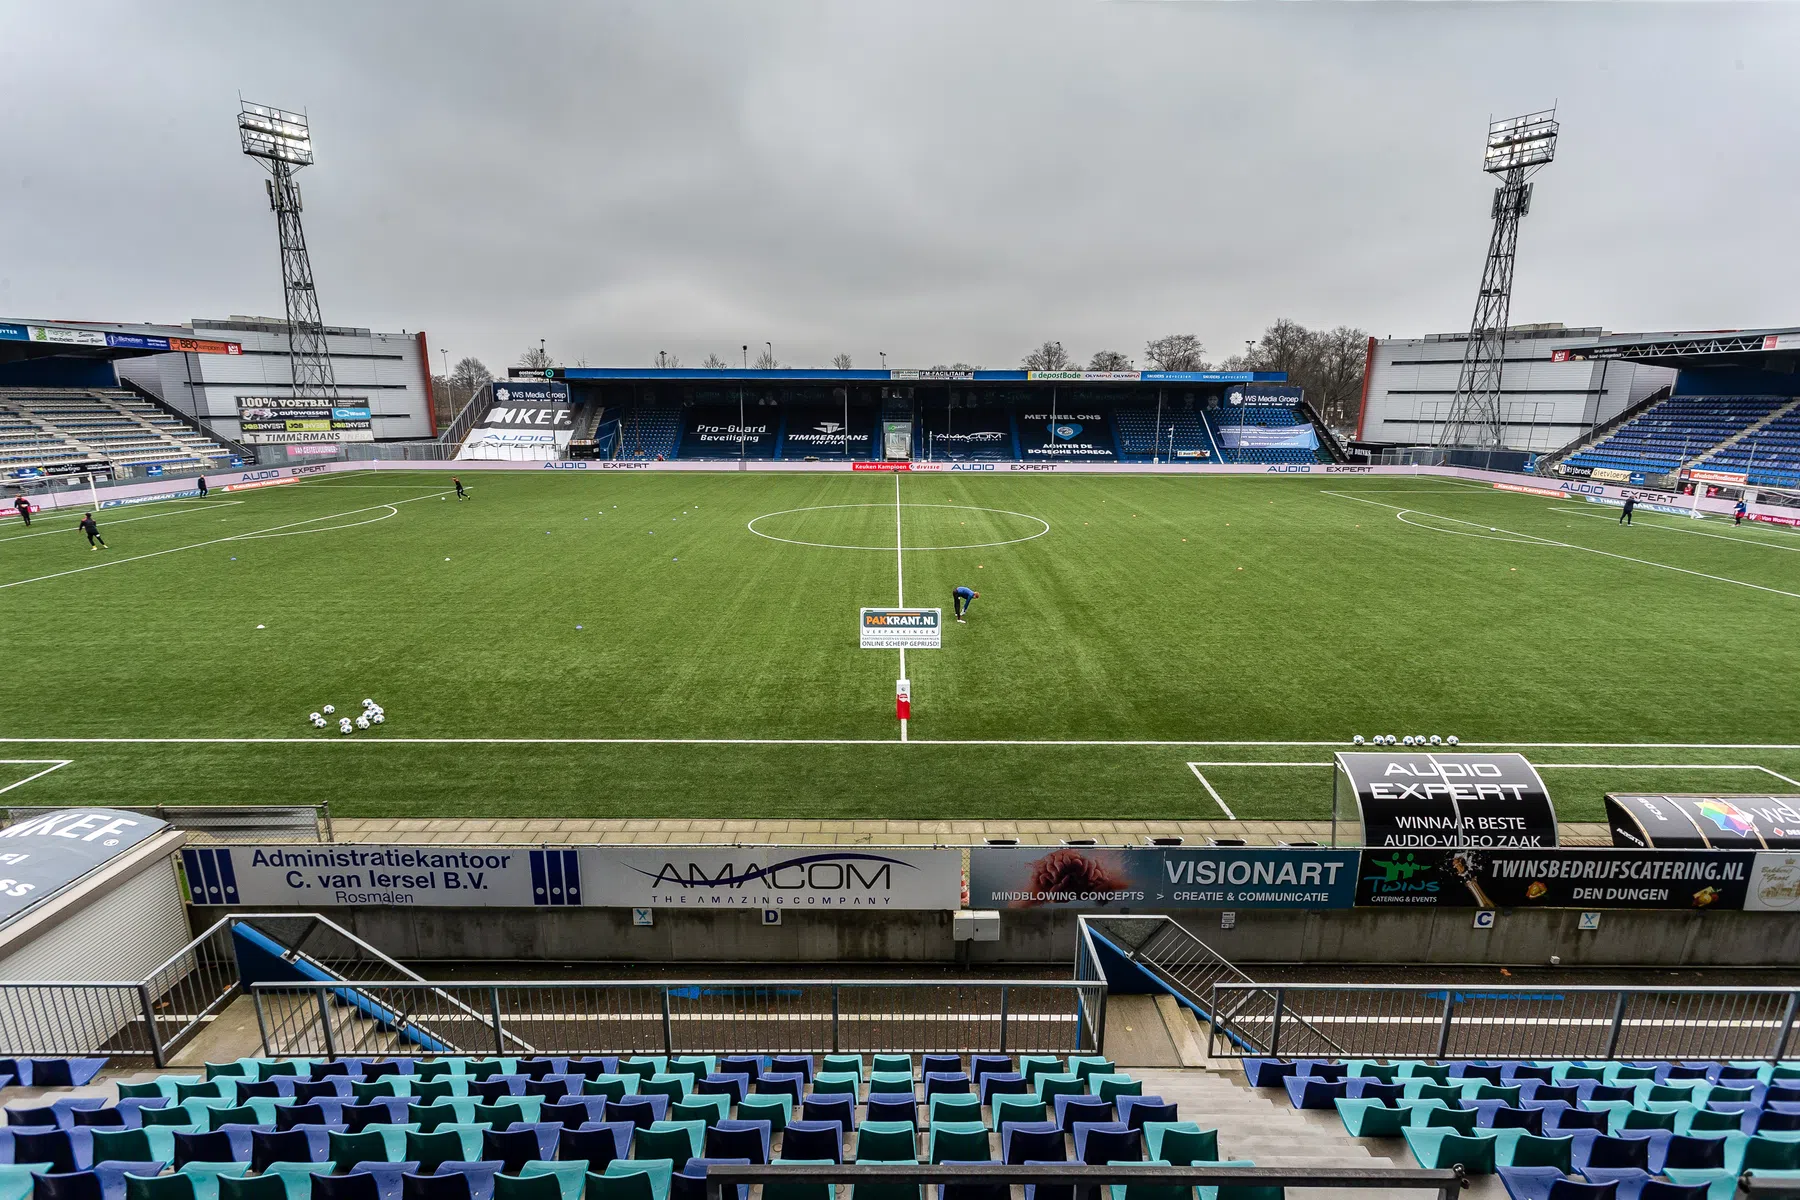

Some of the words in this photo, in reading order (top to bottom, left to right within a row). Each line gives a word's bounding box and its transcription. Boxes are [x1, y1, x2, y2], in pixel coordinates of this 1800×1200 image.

[1038, 372, 1082, 380] depostBode
[511, 391, 525, 399] WS
[525, 391, 546, 399] Media
[546, 391, 566, 400] Groep
[1278, 395, 1299, 404] Groep
[240, 397, 278, 407] 100%
[278, 398, 333, 407] VOETBAL
[696, 424, 767, 433] Pro-Guard
[265, 432, 341, 442] TIMMERMANS
[483, 433, 555, 442] AUDIO
[700, 434, 760, 443] Beveiliging
[855, 463, 877, 471] Keuken
[878, 463, 907, 471] Kampioen
[951, 463, 995, 471] AUDIO
[1566, 465, 1592, 476] Rijbroek
[242, 470, 280, 482] AUDIO
[291, 465, 327, 475] EXPERT
[1559, 481, 1604, 495] AUDIO
[1620, 489, 1679, 504] EXPERT
[120, 493, 176, 505] TIMMERMANS
[866, 615, 936, 626] PAKKRANT.NL
[1384, 762, 1503, 777] AUDIO
[1369, 782, 1529, 801] EXPERT
[1395, 816, 1475, 830] WINNAAR
[1479, 816, 1527, 830] BESTE
[1383, 834, 1493, 847] AUDIO-VIDEO
[1496, 834, 1541, 848] ZAAK
[251, 849, 511, 869] Administratiekantoor
[651, 862, 892, 890] AMACOM
[1165, 860, 1345, 886] VISIONART
[1491, 859, 1745, 881] TWINSBEDRIJFSCATERING.NL
[286, 871, 305, 889] C.
[318, 875, 362, 889] van
[370, 870, 436, 889] Iersel
[443, 872, 489, 890] B.V.
[336, 890, 414, 905] Rosmalen
[991, 891, 1078, 901] MINDBLOWING
[1080, 891, 1145, 901] CONCEPTS
[1173, 891, 1224, 901] CREATIE
[1227, 891, 1235, 901] &
[1237, 891, 1329, 902] COMMUNICATIE
[1371, 895, 1405, 903] CATERING
[1572, 887, 1602, 900] DEN
[1605, 888, 1669, 900] DUNGEN
[651, 895, 687, 904] THE
[697, 896, 785, 905] AMAZING
[793, 896, 891, 905] COMPANY
[764, 910, 779, 923] D
[1477, 912, 1492, 926] C
